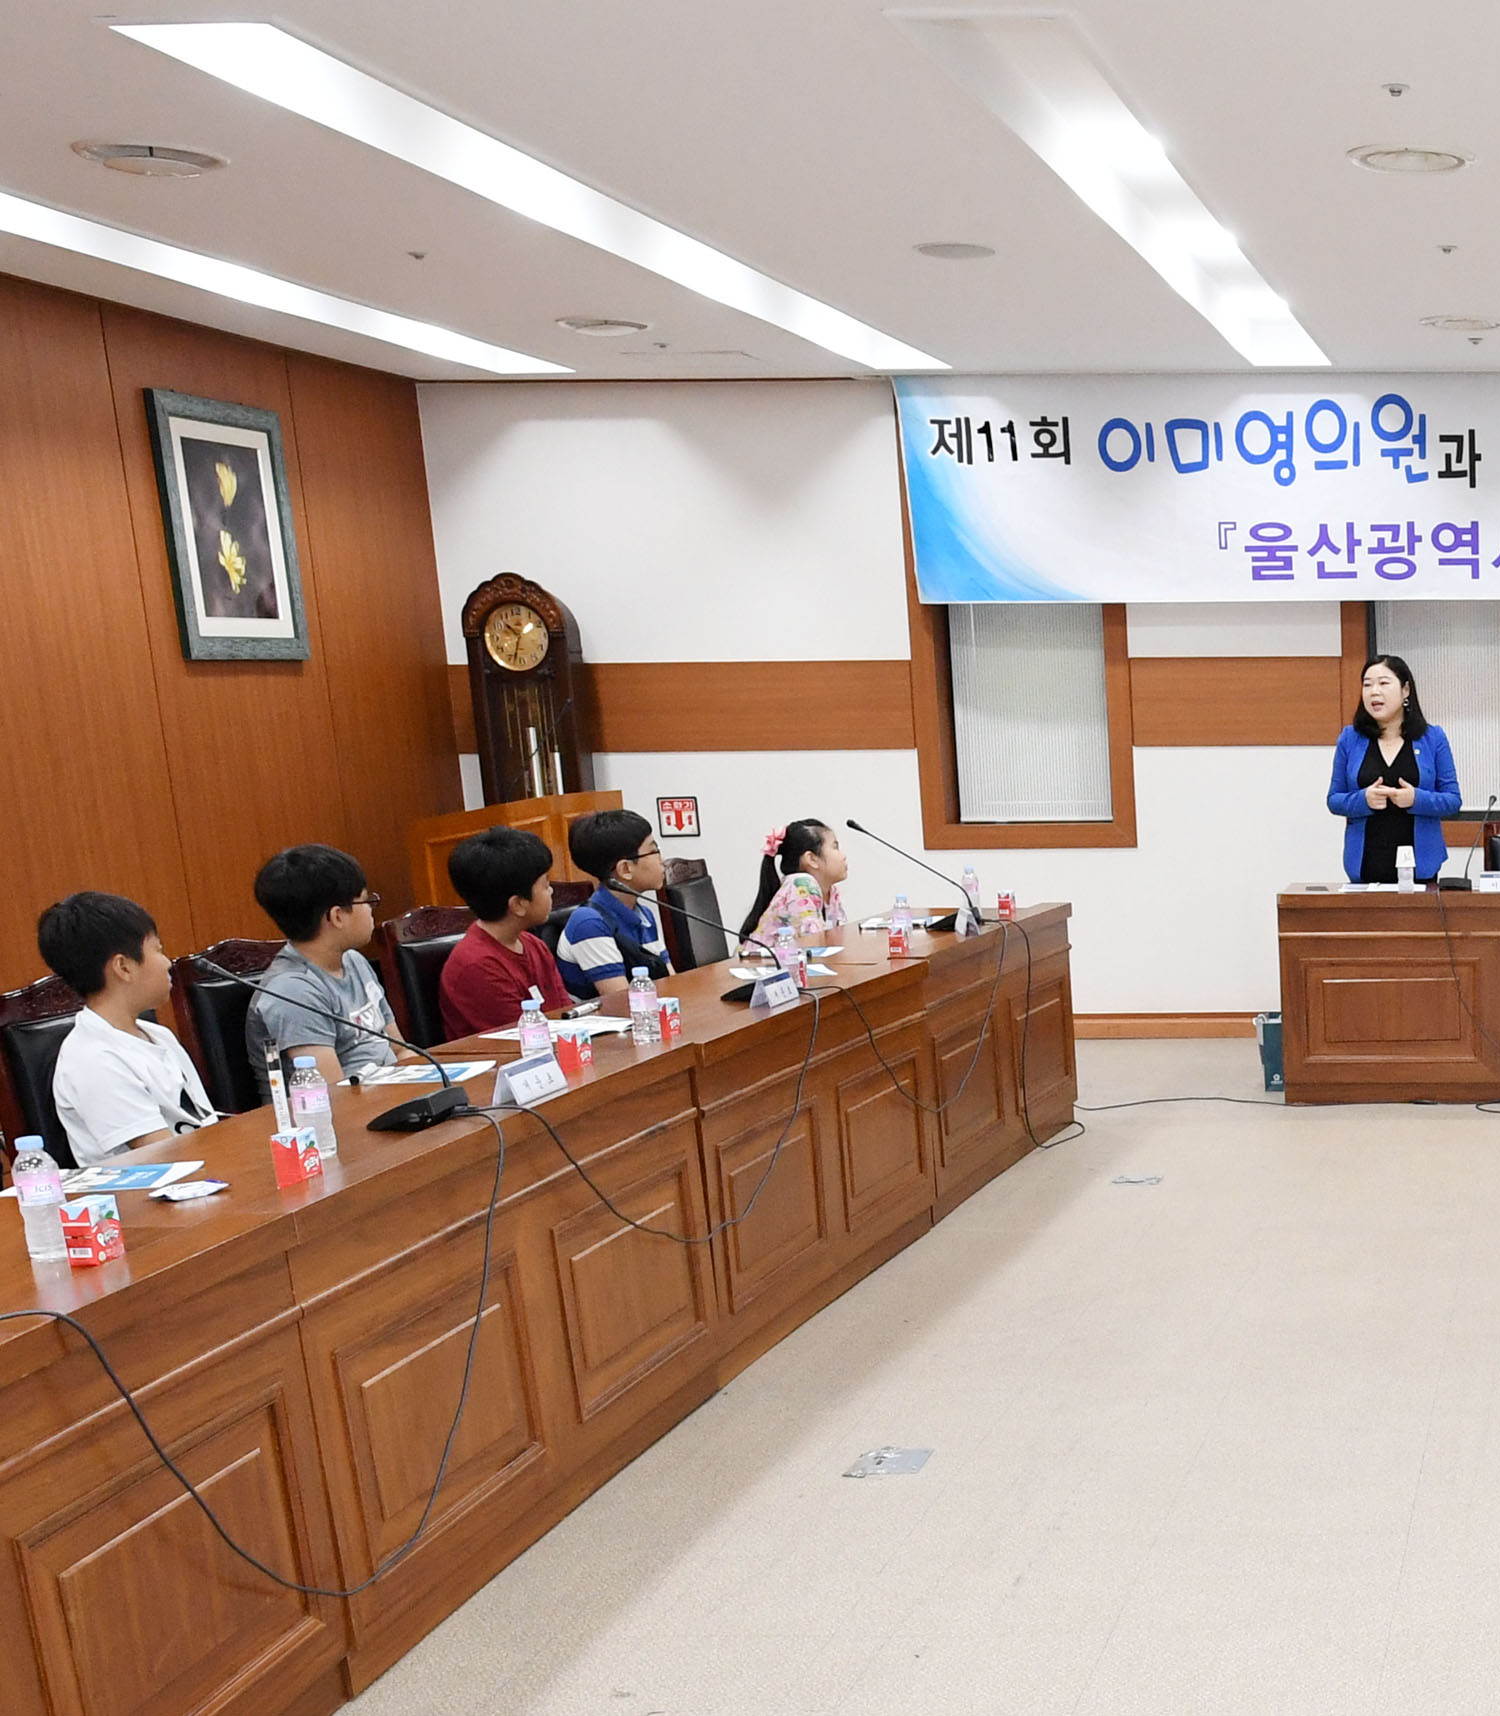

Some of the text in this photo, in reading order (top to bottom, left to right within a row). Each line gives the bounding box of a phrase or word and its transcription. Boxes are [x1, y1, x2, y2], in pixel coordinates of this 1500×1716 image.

[929, 415, 1072, 465] 제11회
[1098, 393, 1482, 489] 이미영의원과
[662, 801, 694, 810] 소화기
